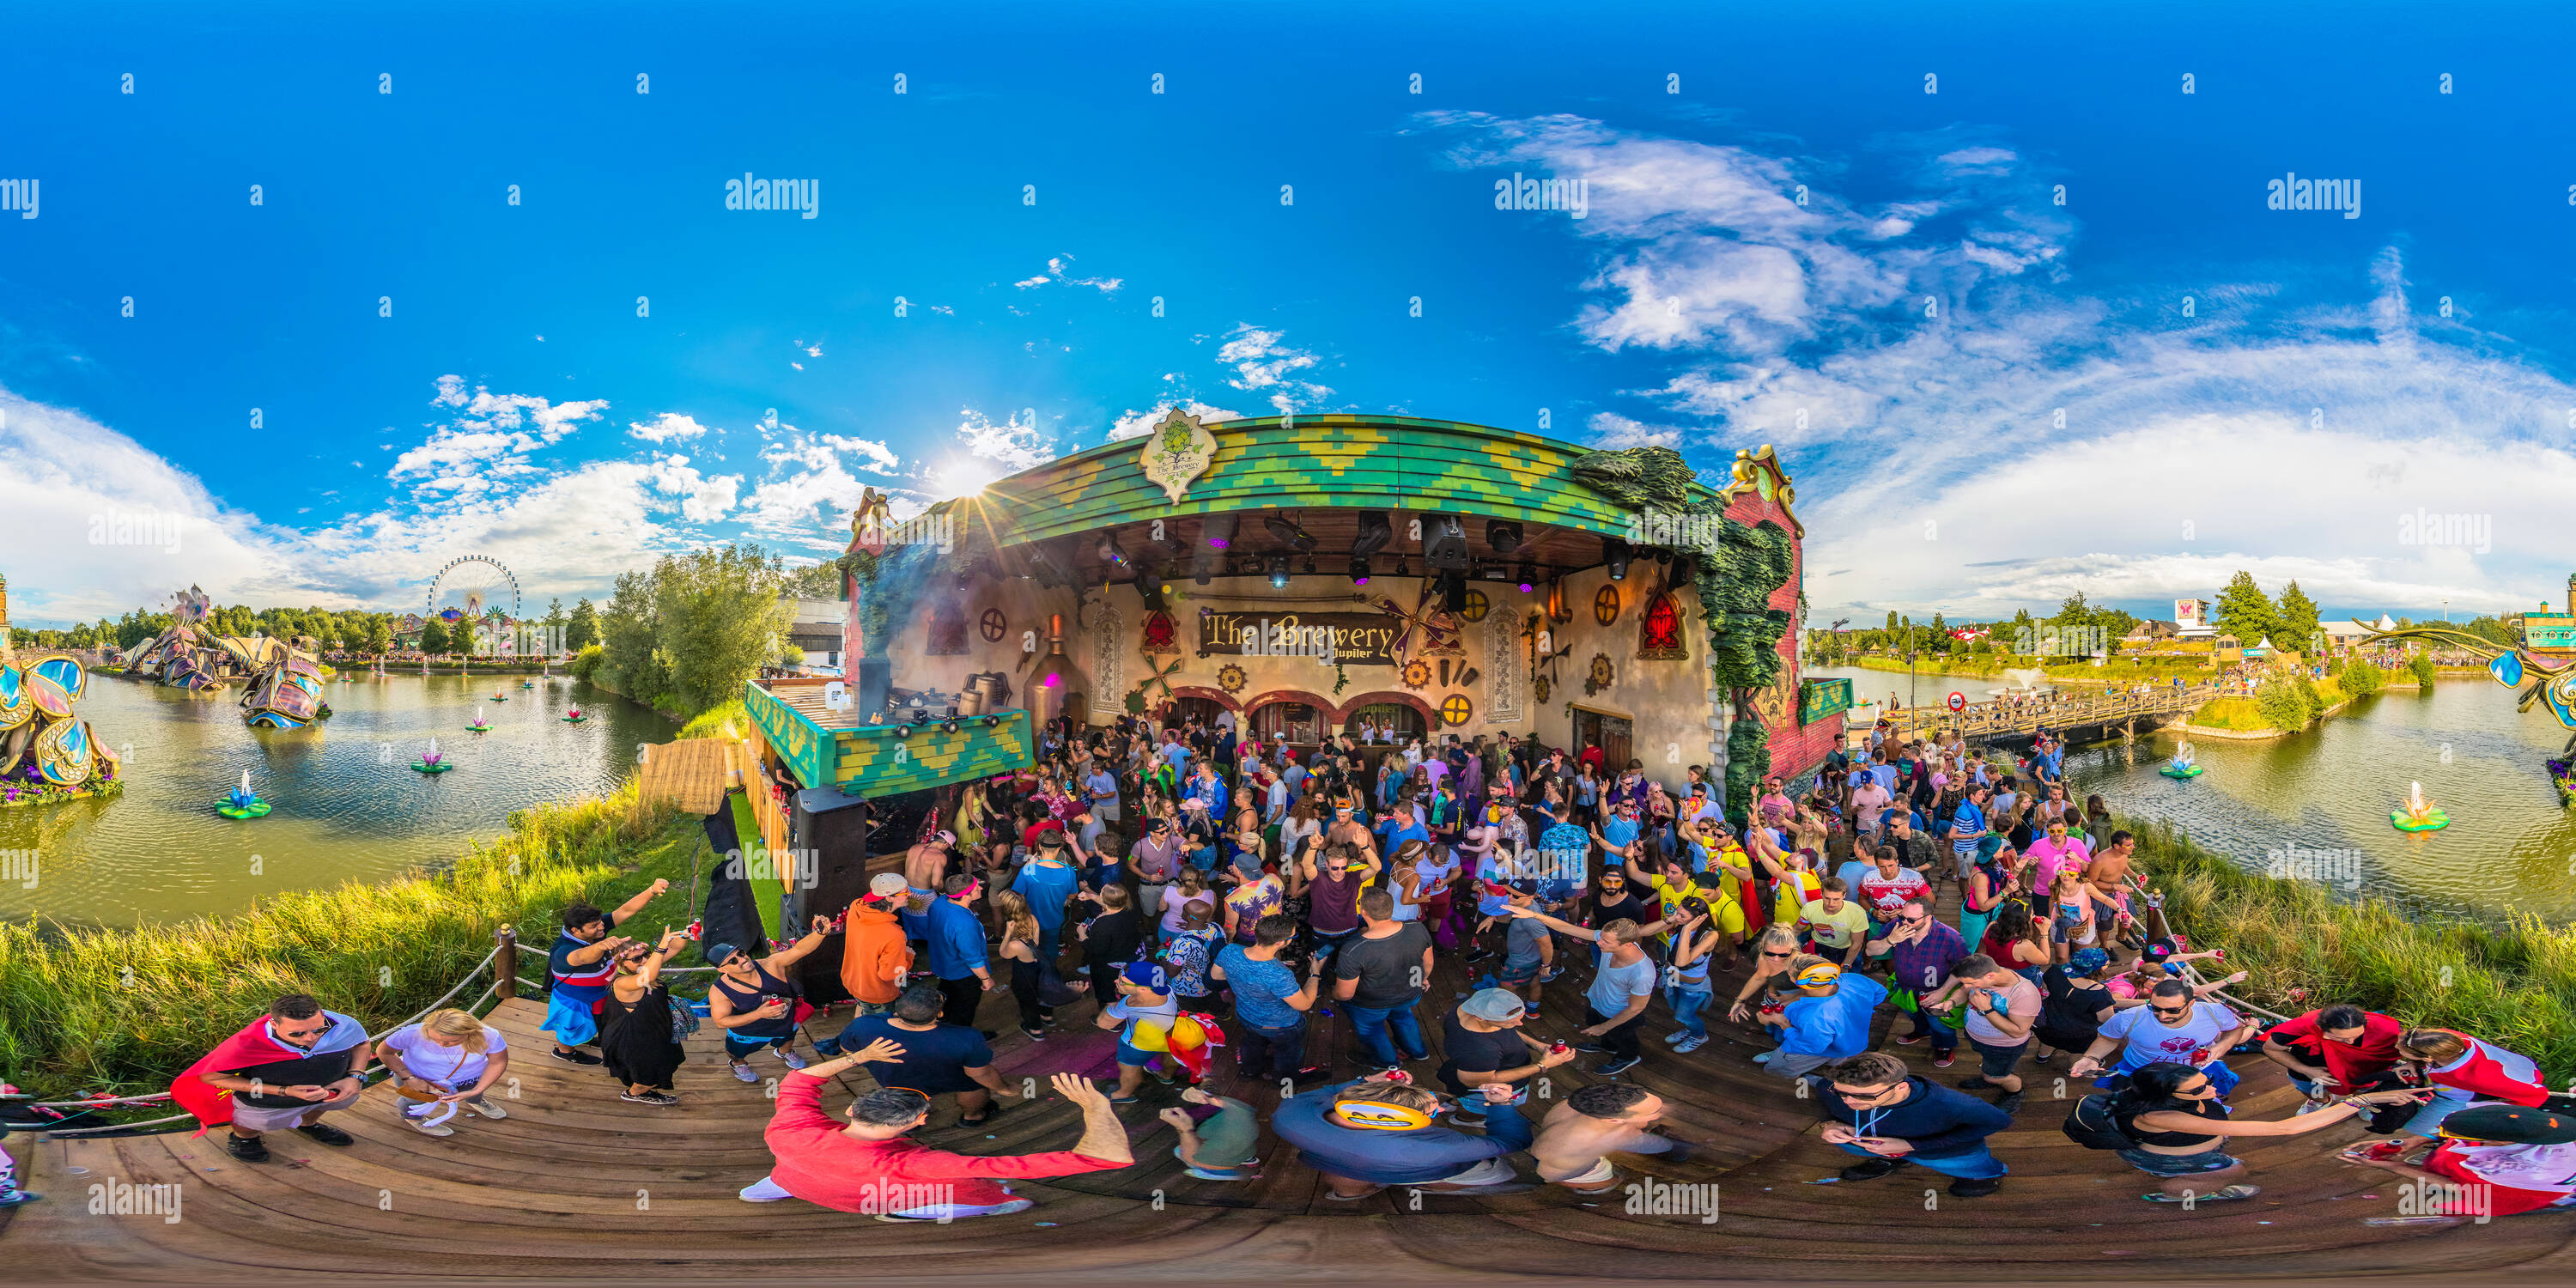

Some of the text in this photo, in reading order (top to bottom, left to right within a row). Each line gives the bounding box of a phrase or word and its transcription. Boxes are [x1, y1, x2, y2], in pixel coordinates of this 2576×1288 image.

[1173, 462, 1200, 471] Brewery
[1204, 615, 1394, 658] The Brewery
[1332, 647, 1374, 659] Jupiler
